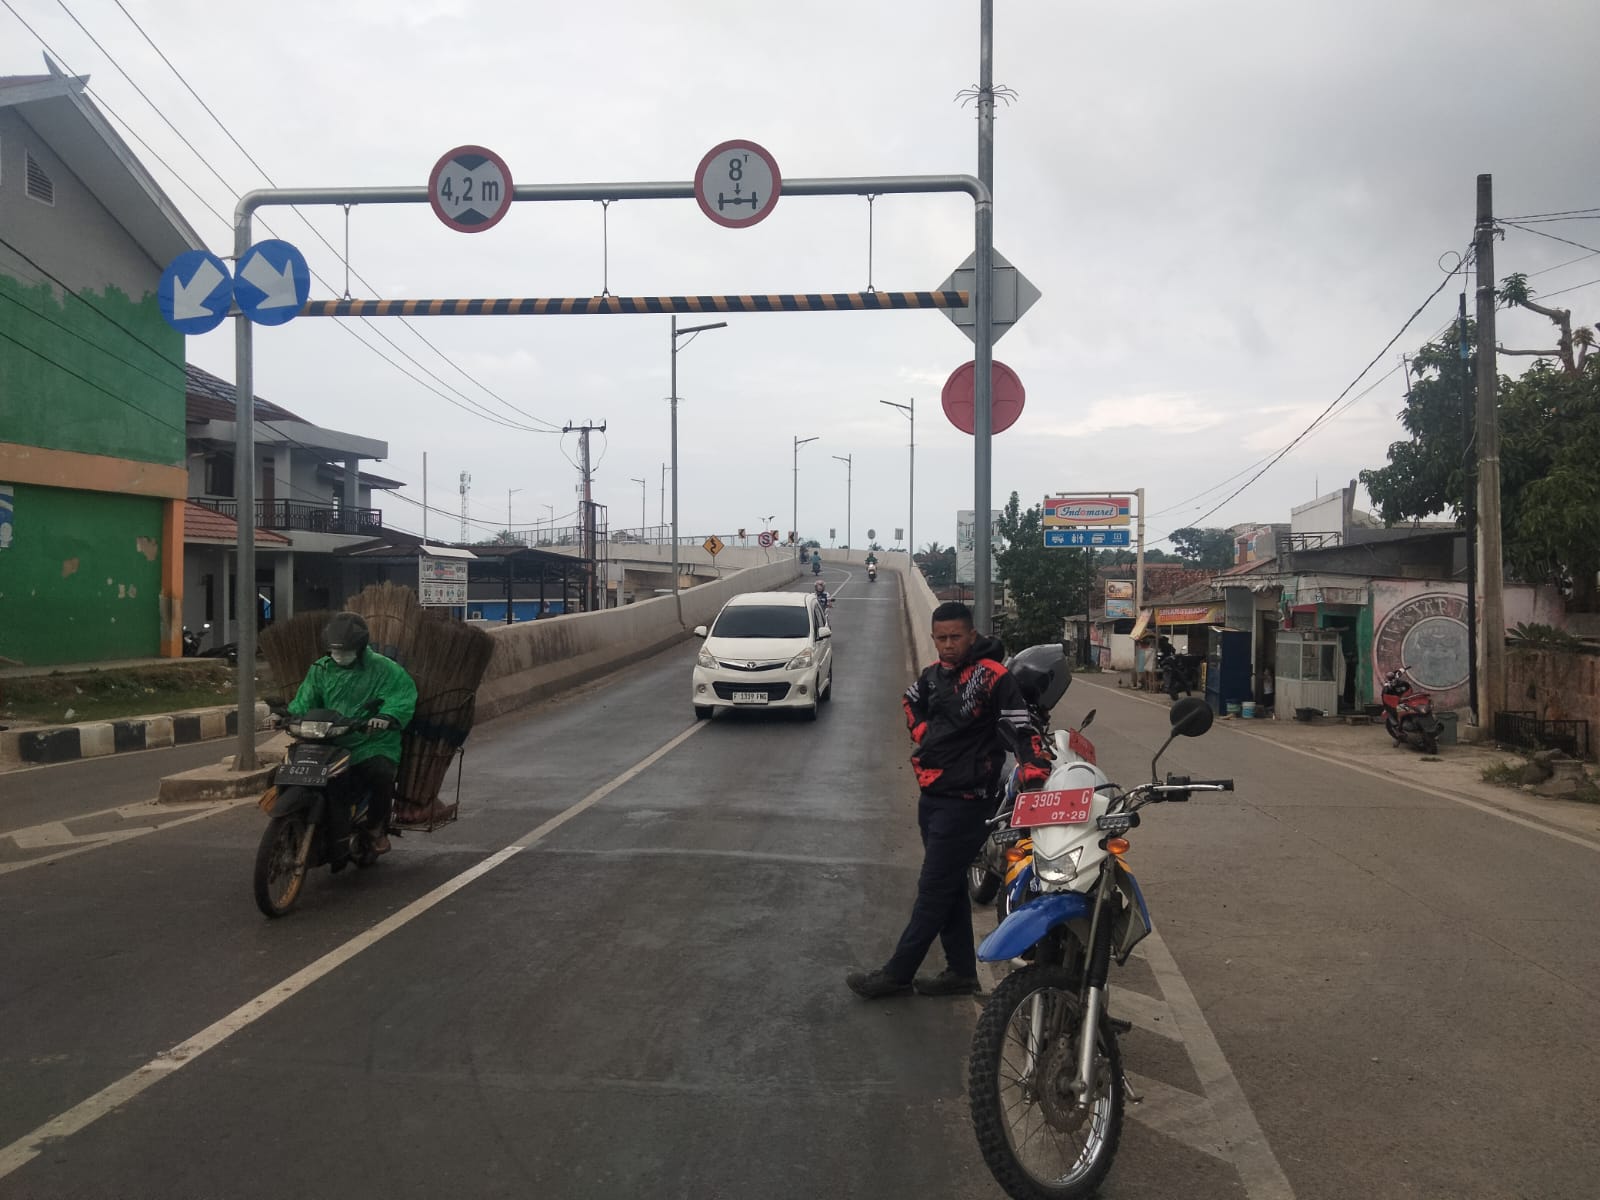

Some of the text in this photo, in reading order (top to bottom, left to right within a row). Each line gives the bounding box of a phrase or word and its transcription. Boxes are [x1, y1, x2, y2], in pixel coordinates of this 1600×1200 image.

[441, 176, 499, 206] 4,2 m
[1017, 790, 1091, 810] F 3905 G
